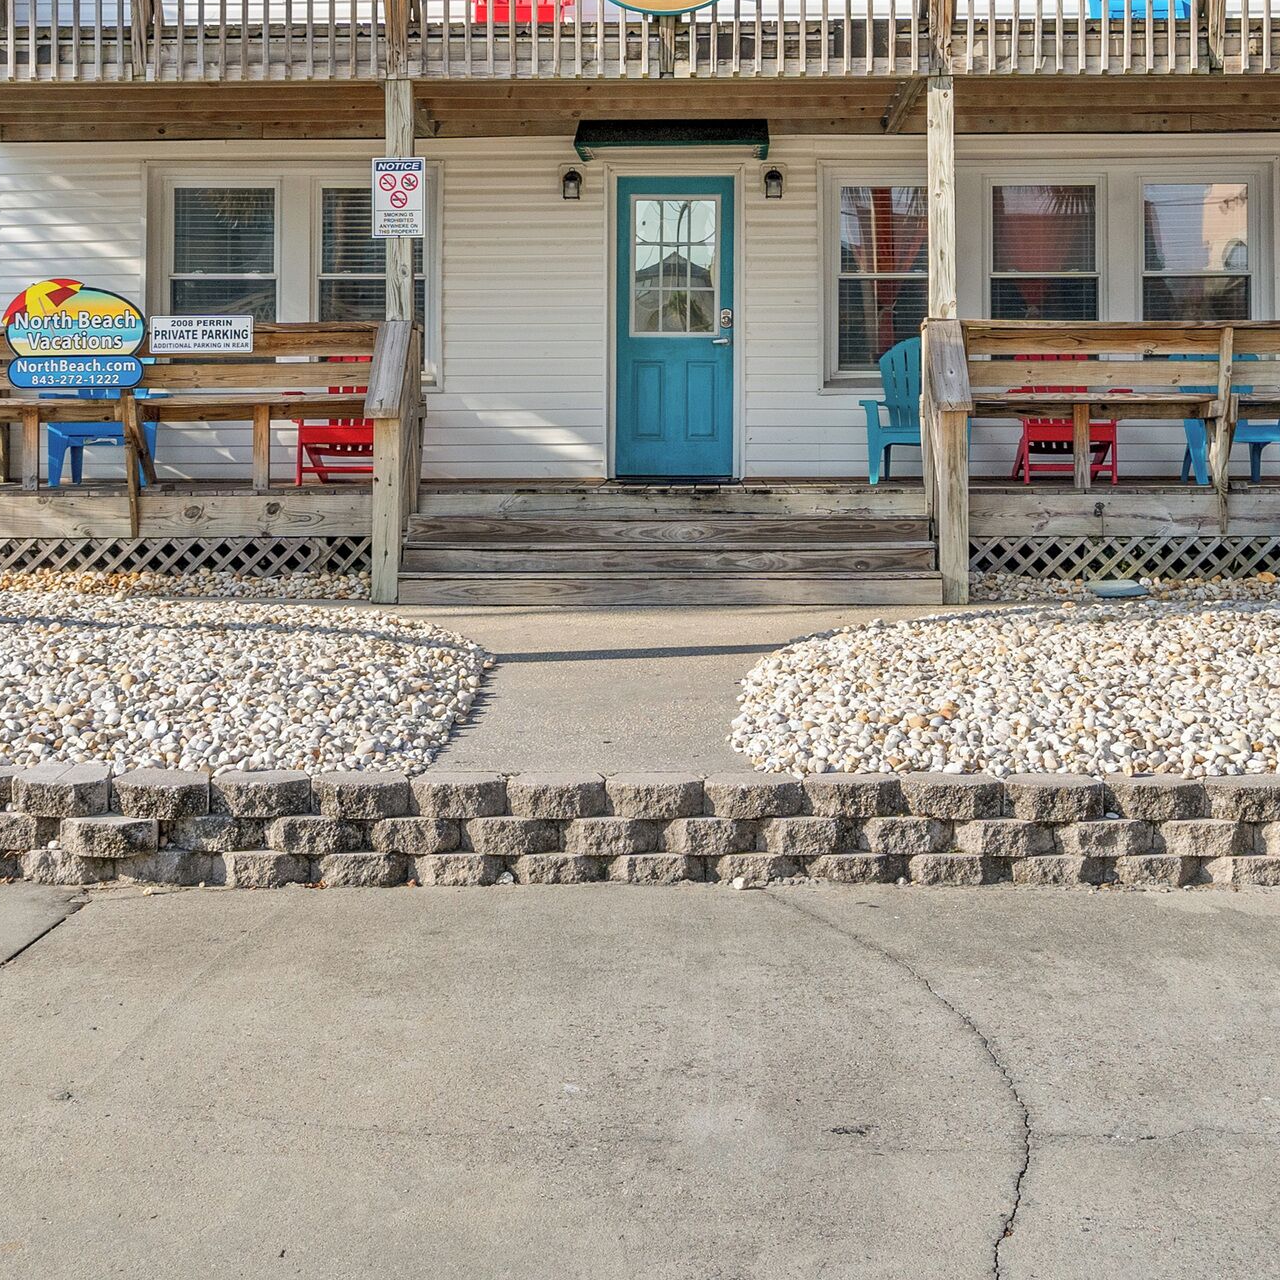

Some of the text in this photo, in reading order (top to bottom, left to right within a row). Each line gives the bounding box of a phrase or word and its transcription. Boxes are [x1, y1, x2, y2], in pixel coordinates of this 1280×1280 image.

[378, 162, 420, 170] NOTICE
[14, 308, 136, 330] North Beach
[196, 319, 233, 327] PERRIN
[154, 329, 249, 340] PRIVATE PARKING
[27, 331, 123, 350] Vacations
[17, 358, 136, 373] NorthBeach.com
[31, 374, 120, 385] 843-272-1222
